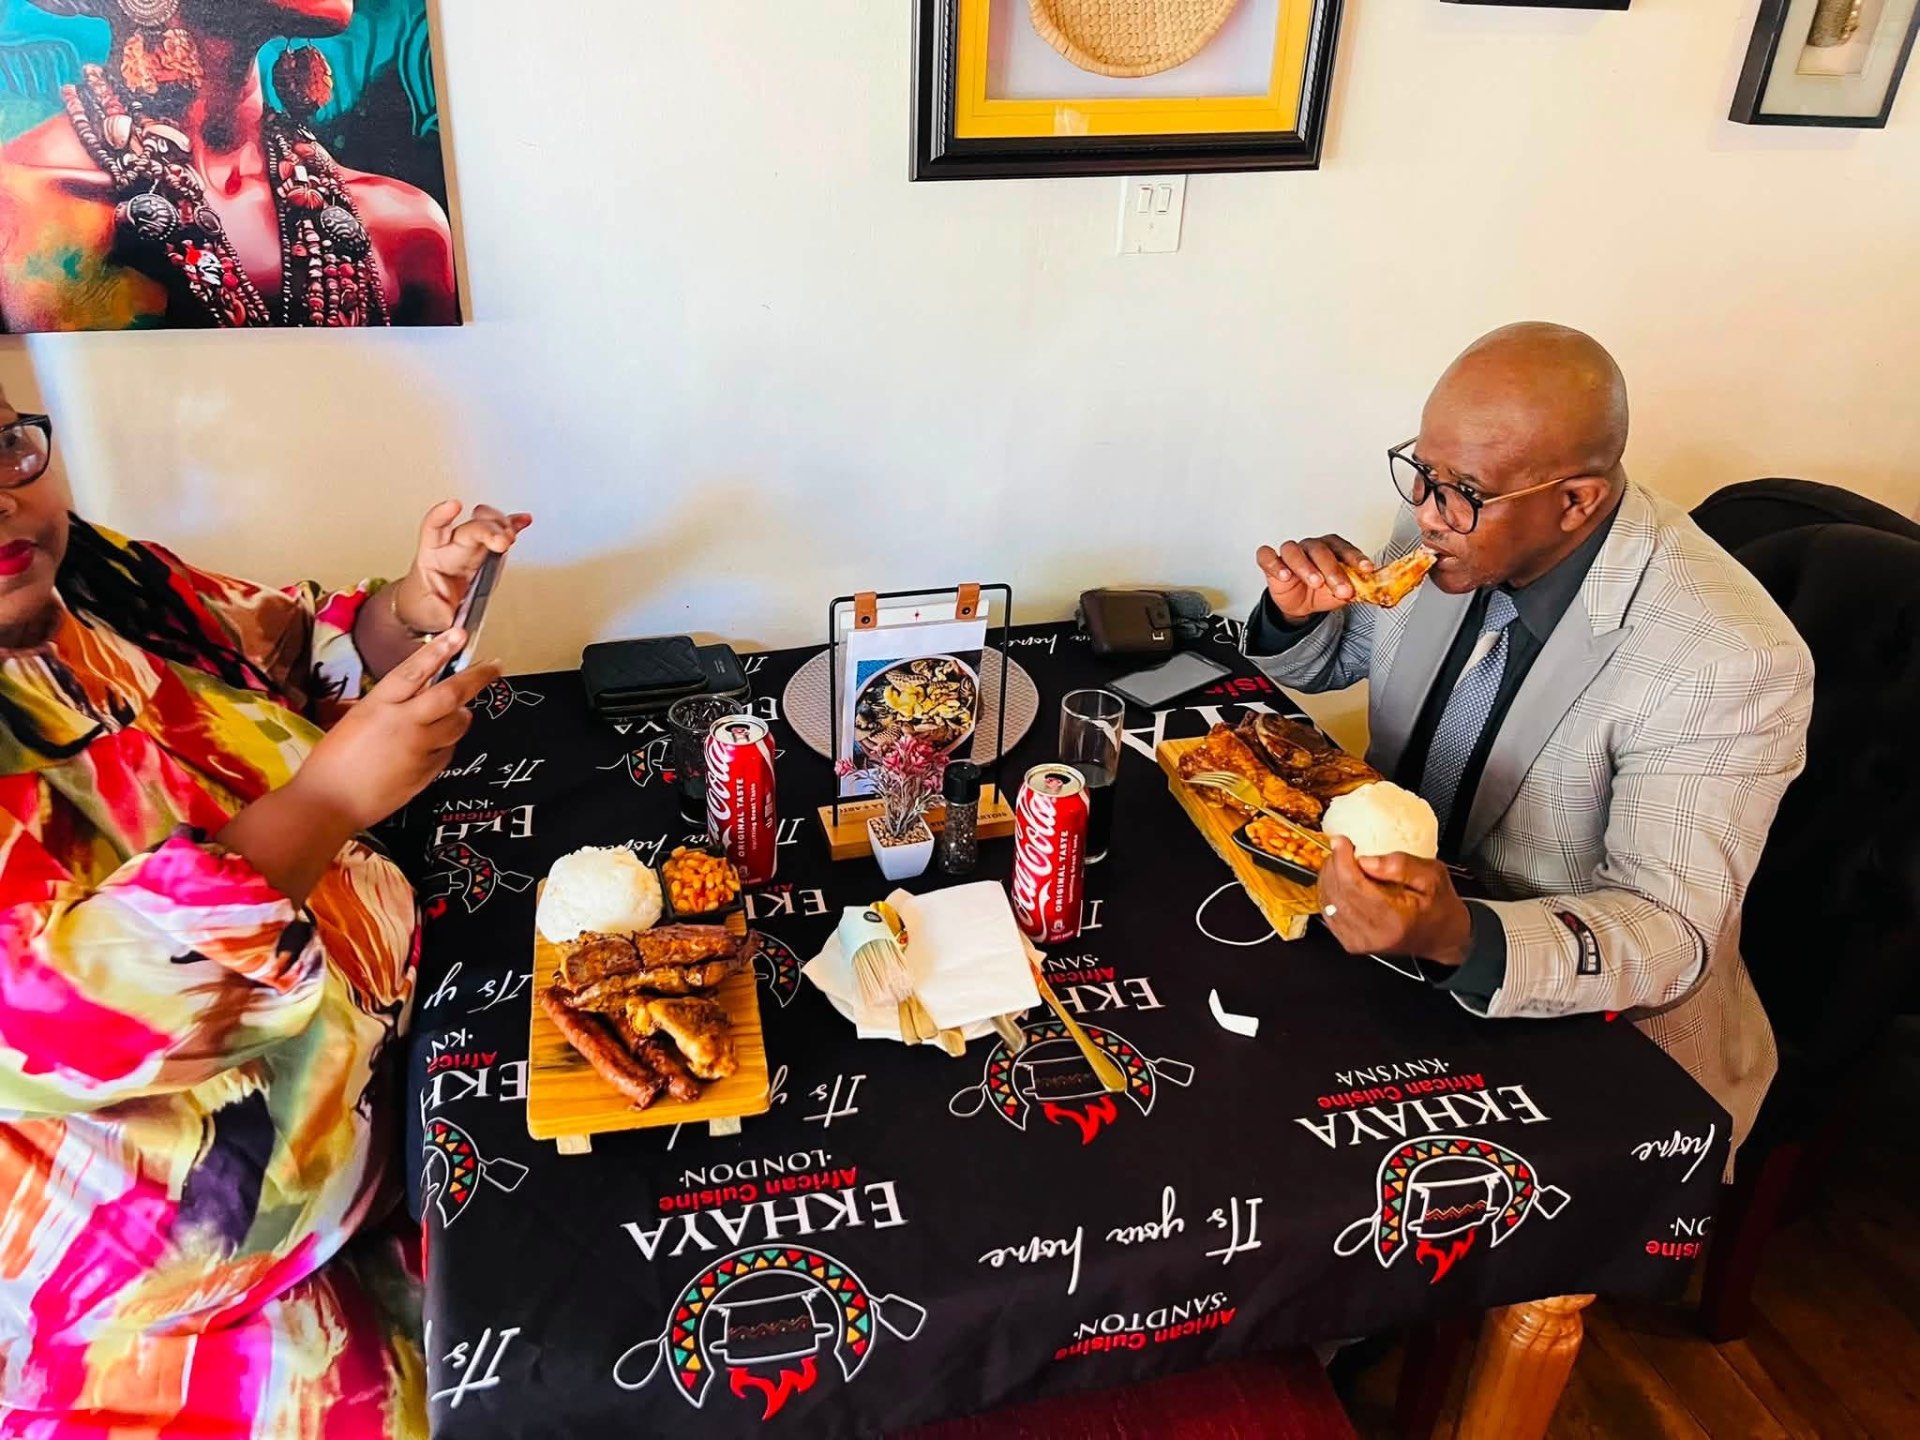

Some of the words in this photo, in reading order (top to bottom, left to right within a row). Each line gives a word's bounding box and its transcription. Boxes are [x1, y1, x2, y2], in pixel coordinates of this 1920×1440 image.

[438, 753, 488, 780] you
[735, 778, 745, 809] TASTE
[737, 811, 746, 858] ORIGINAL
[1058, 830, 1069, 863] TASTE
[1054, 864, 1066, 913] ORIGINAL
[1316, 1086, 1403, 1111] Cuisine
[1404, 1072, 1486, 1095] African
[1293, 1084, 1552, 1149] EKHAYA
[1631, 1123, 1716, 1183] home
[658, 1182, 759, 1212] Cuisine
[767, 1165, 860, 1197] African
[620, 1179, 909, 1262] EKHAYA
[1105, 1186, 1185, 1245] your
[978, 1226, 1083, 1295] home
[1154, 1307, 1238, 1343] African
[1054, 1332, 1147, 1360] Cuisine
